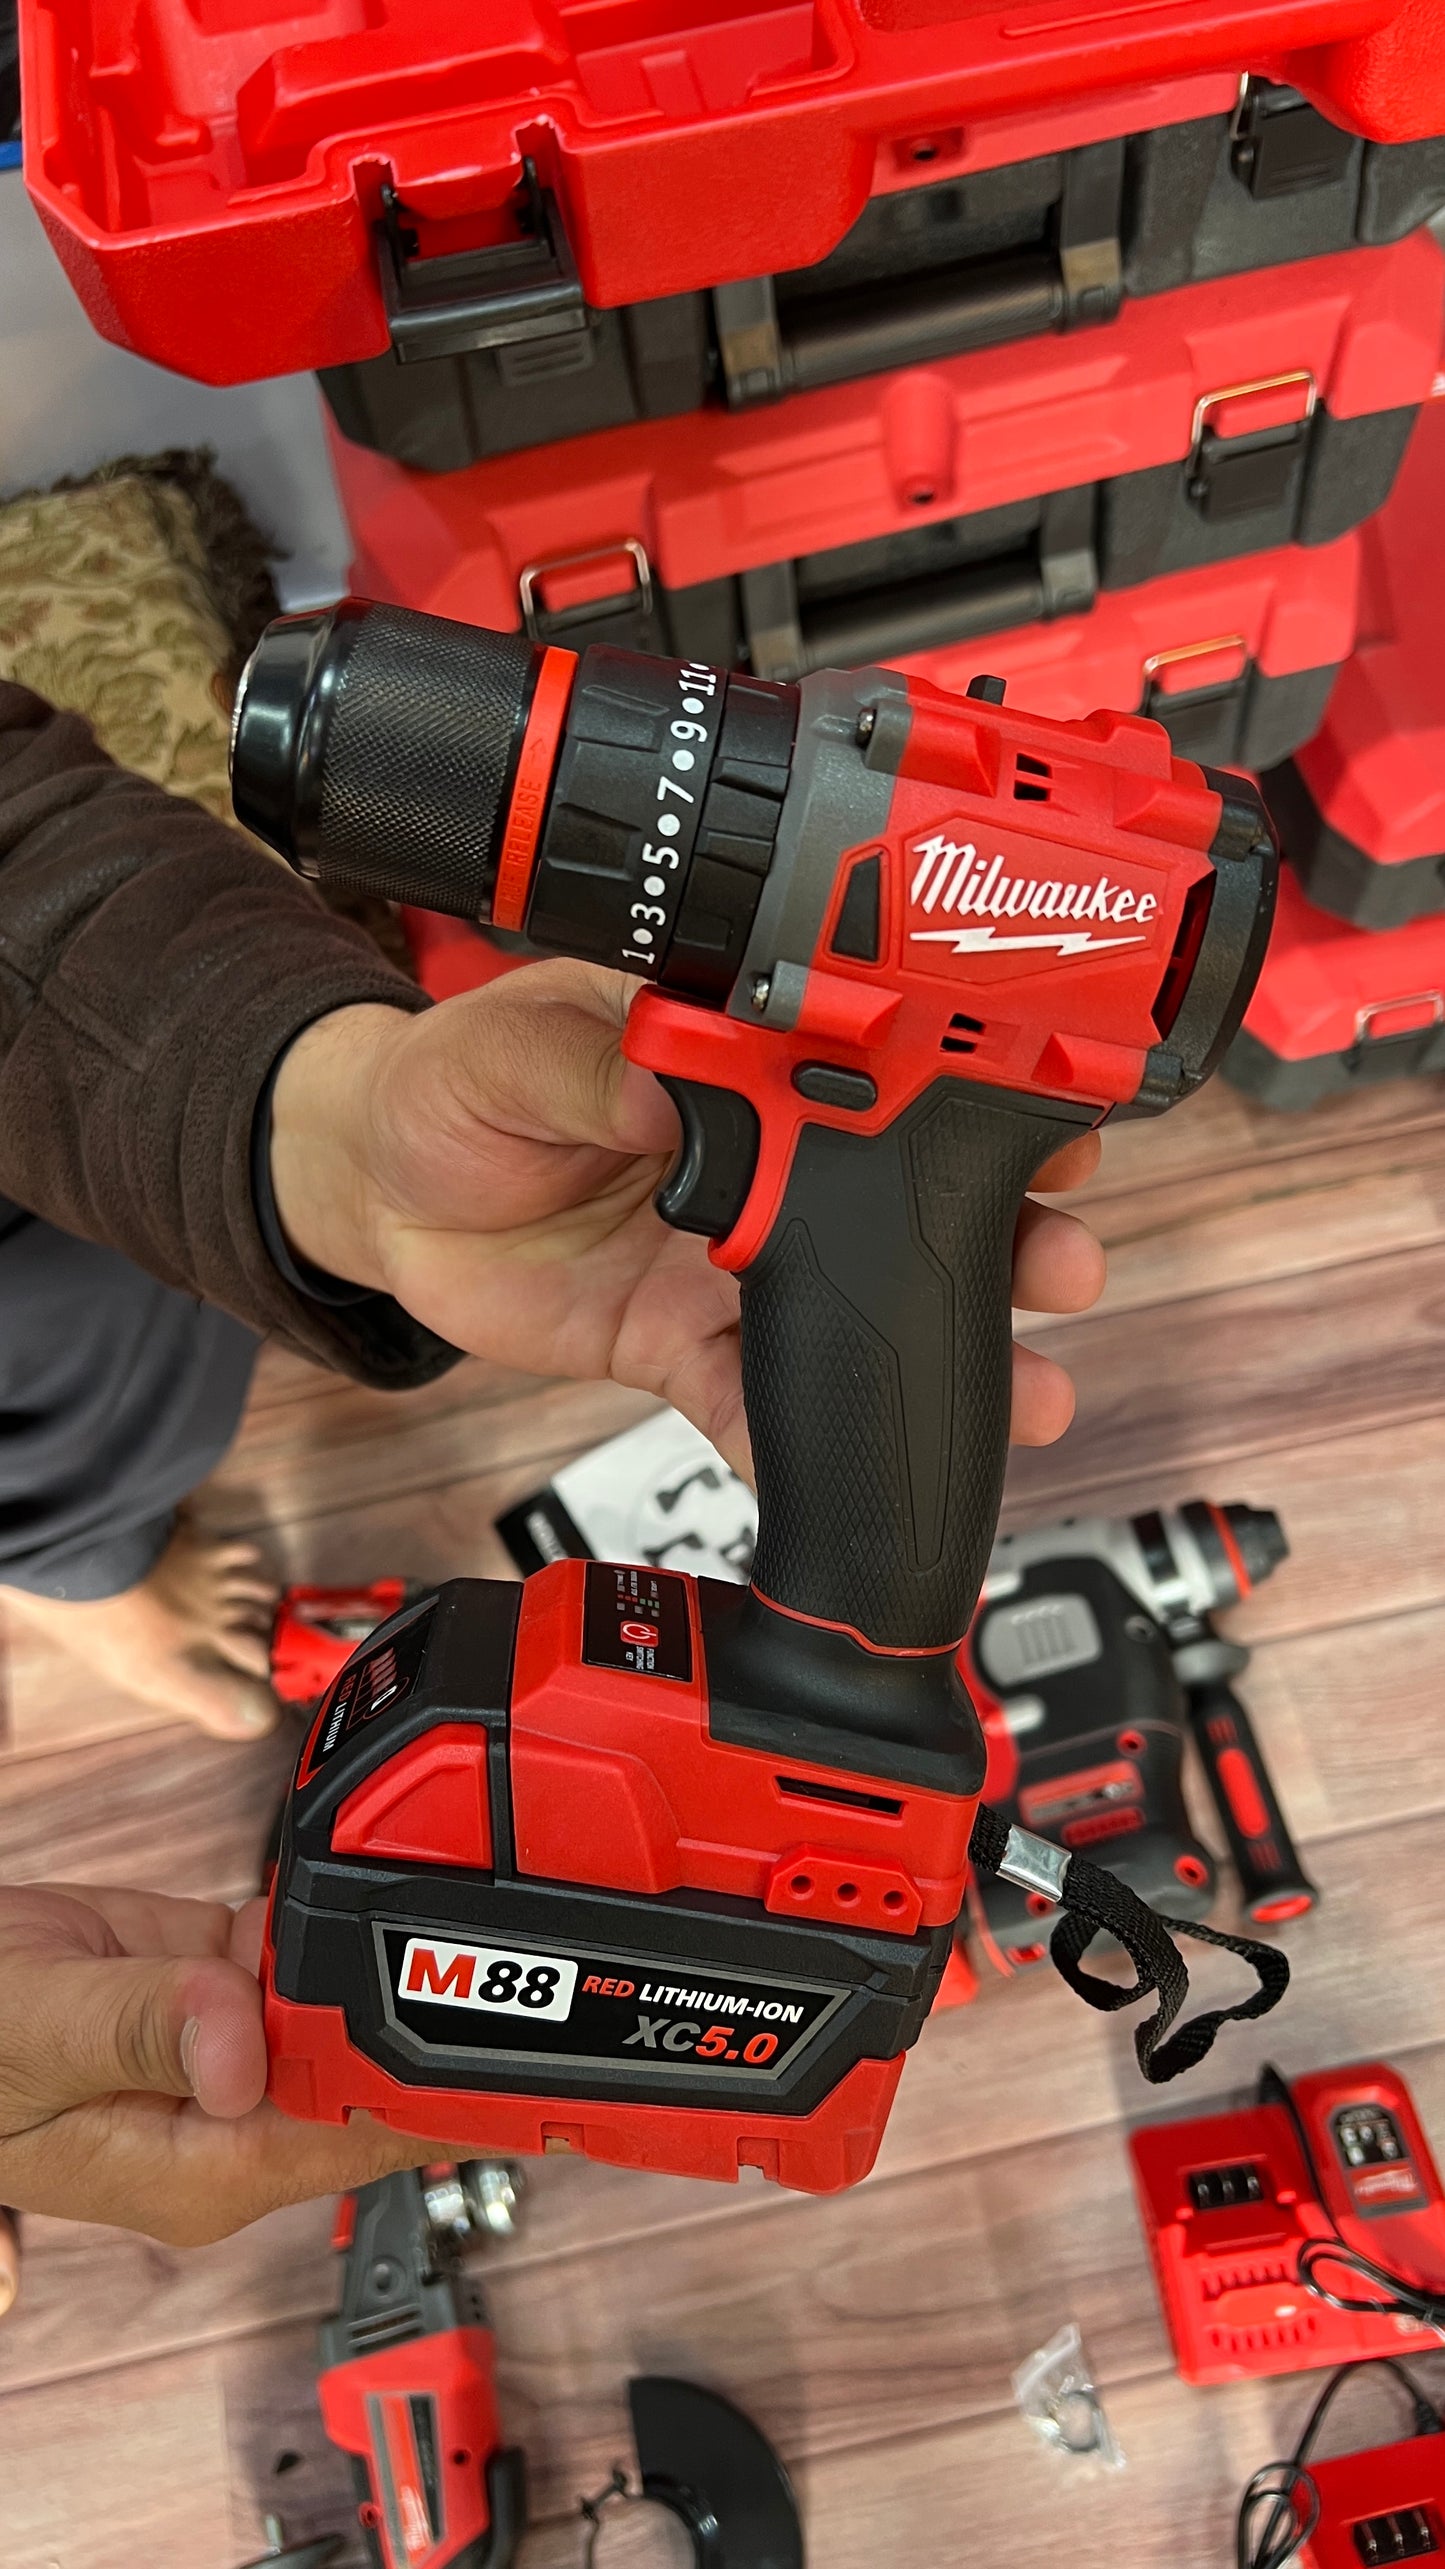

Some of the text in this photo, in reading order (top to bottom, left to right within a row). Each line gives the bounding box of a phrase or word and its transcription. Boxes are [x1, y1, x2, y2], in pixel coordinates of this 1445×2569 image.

[506, 778, 542, 868] RELEASE
[622, 668, 717, 965] 1 3 5 7 9 11
[911, 834, 1157, 923] Milwaukee
[322, 1673, 357, 1752] RED LITHIUM
[405, 1947, 561, 2009] M88
[582, 1975, 804, 2024] RED LITHIUM-ION
[622, 2014, 779, 2064] XC5.0
